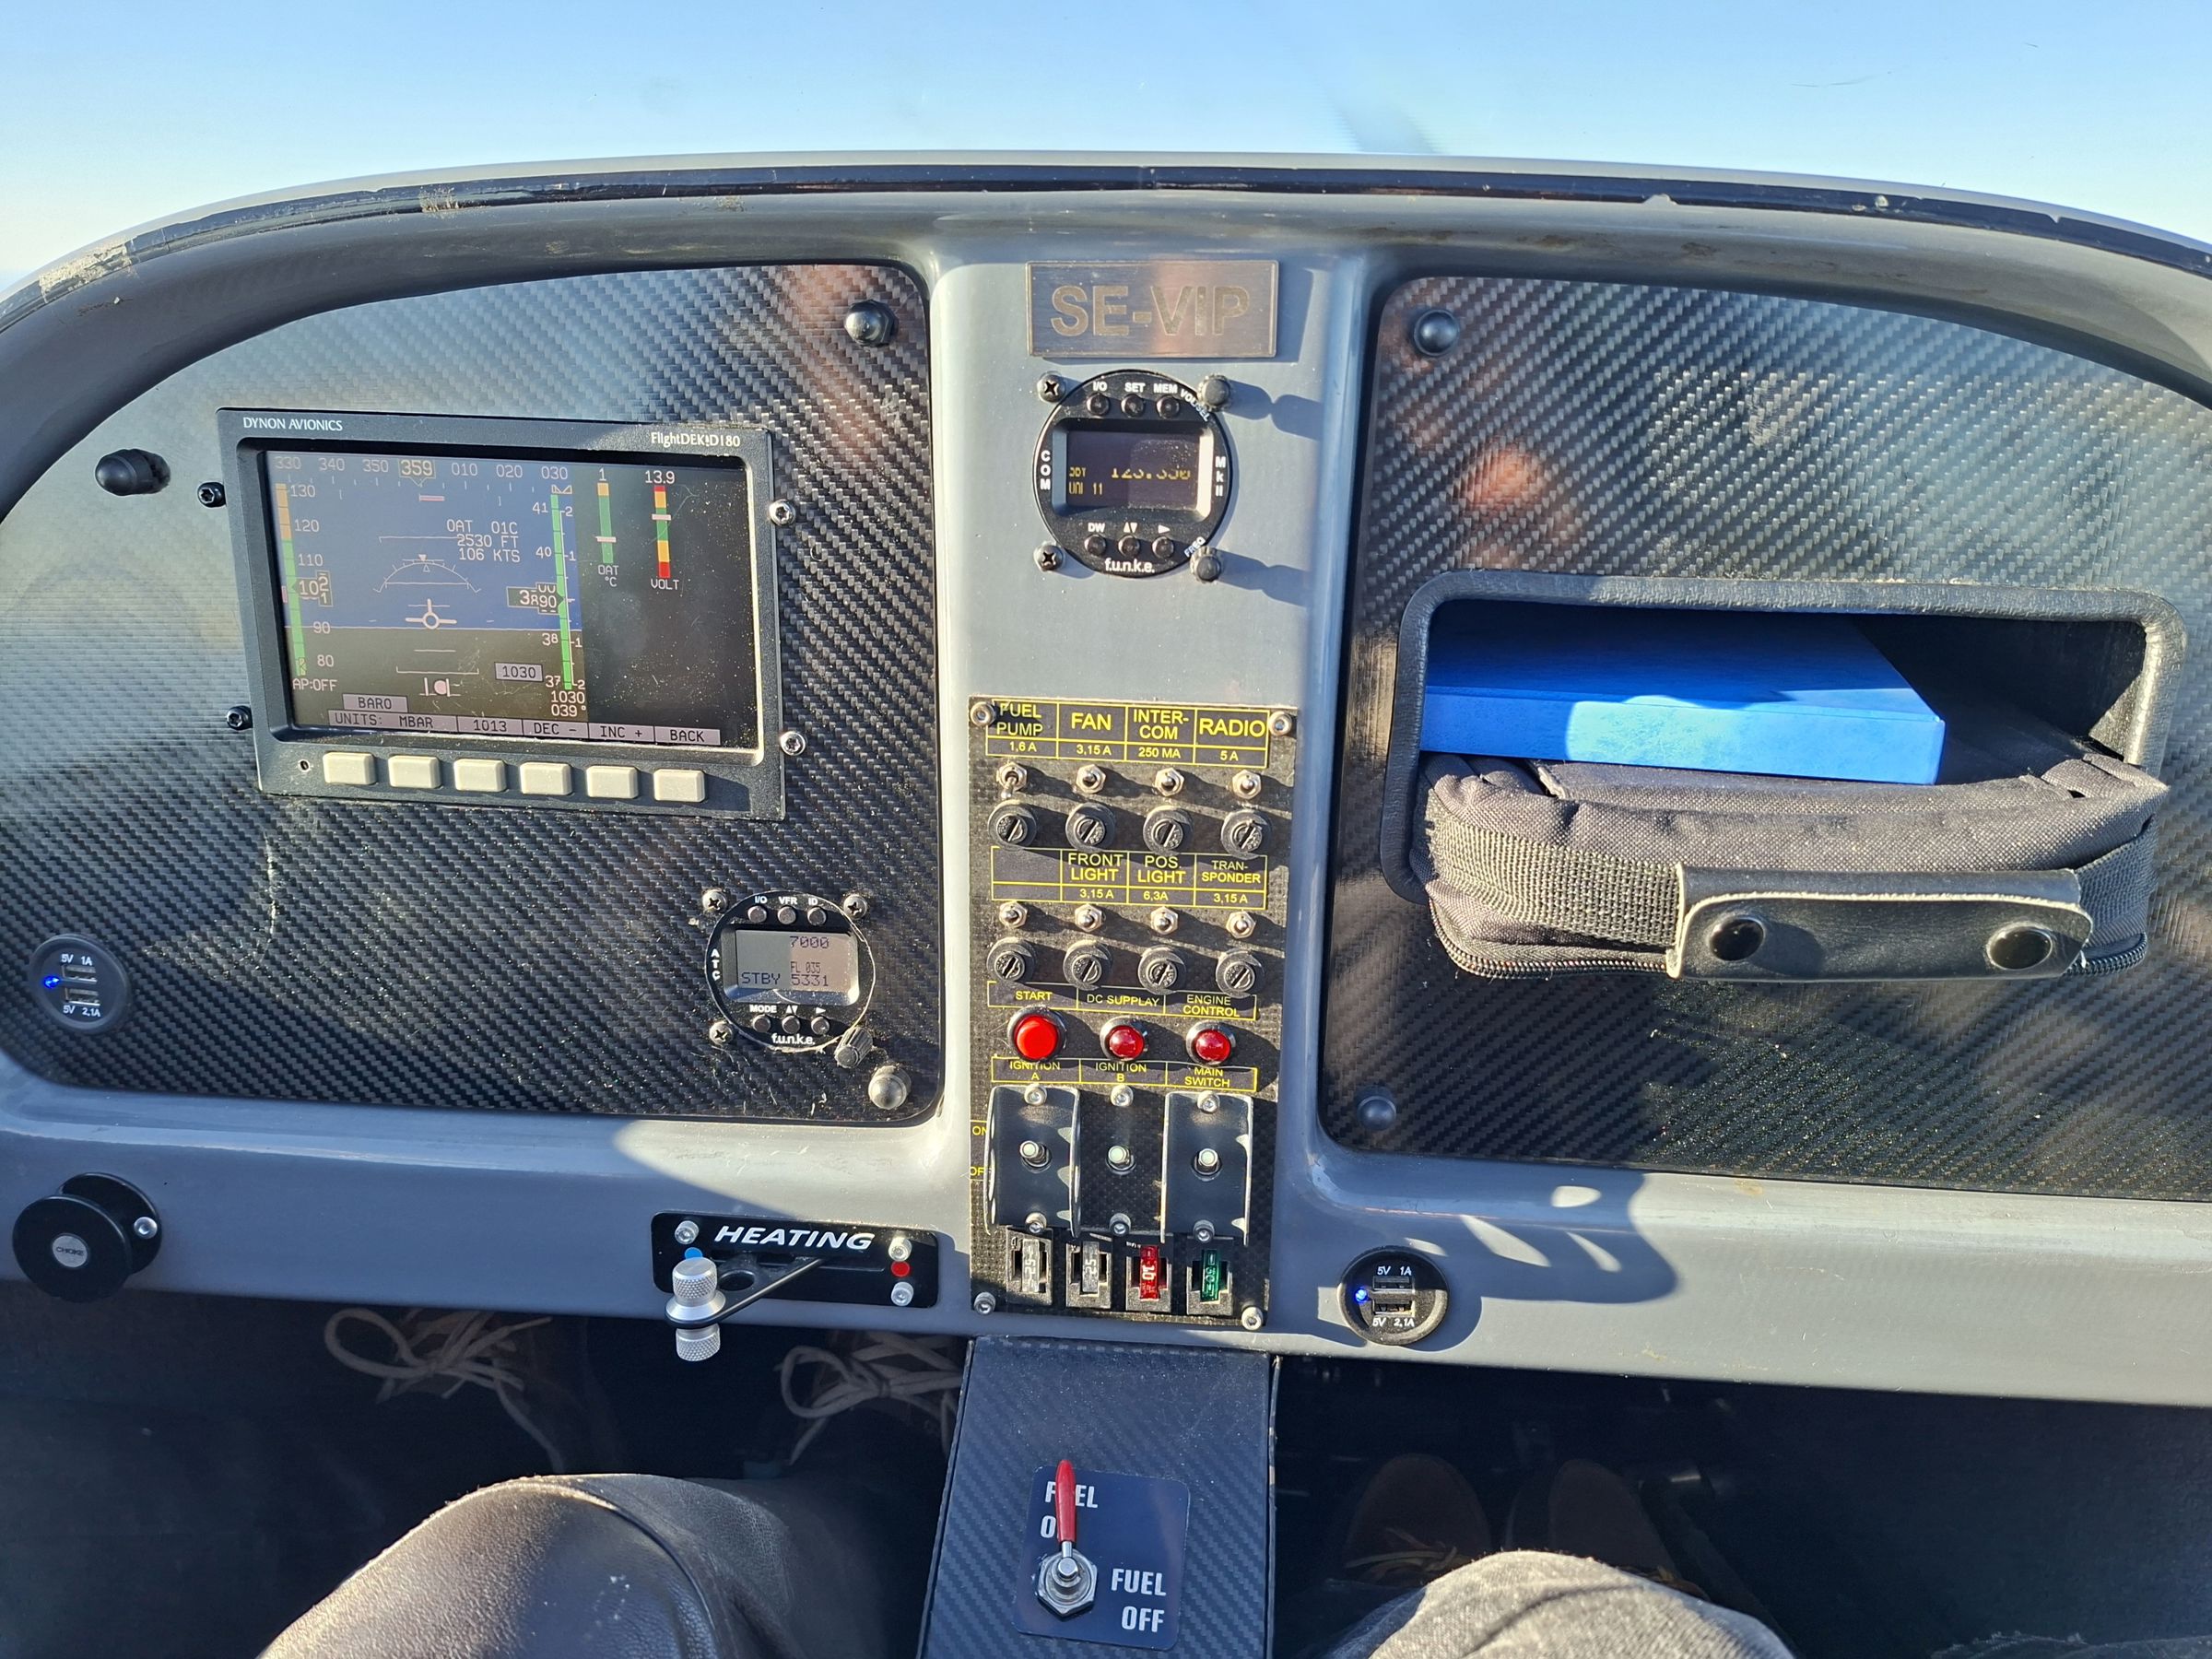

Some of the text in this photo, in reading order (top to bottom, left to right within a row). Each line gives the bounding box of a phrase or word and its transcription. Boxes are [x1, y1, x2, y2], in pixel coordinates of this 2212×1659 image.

[1051, 285, 1250, 335] SE-VIP
[1124, 382, 1145, 393] SET
[1153, 383, 1177, 394] MEM
[242, 417, 343, 431] DYNON AVIONICS
[275, 456, 301, 469] 330
[318, 458, 345, 471] 340
[362, 459, 389, 473] 350
[400, 460, 433, 477] 359
[451, 463, 478, 477] 010
[496, 465, 523, 478] 020
[541, 466, 568, 479] 030
[599, 468, 606, 481] 1
[645, 470, 676, 484] 13.9
[289, 484, 316, 498] 130
[532, 502, 548, 514] 41
[294, 519, 319, 533] 120
[1088, 522, 1105, 532] DW
[457, 535, 518, 548] 2530 FT
[459, 547, 521, 563] 106 KTS
[535, 547, 552, 558] 40
[298, 553, 324, 566] 110
[597, 564, 619, 576] OAT
[651, 579, 679, 591] VOLT
[312, 622, 331, 634] 90
[542, 632, 559, 646] 38
[317, 654, 335, 667] 80
[501, 665, 536, 678] 1030
[292, 678, 337, 691] AP:OFF
[545, 675, 561, 688] 37
[358, 697, 393, 710] BARO
[550, 690, 585, 704] 1030
[998, 702, 1042, 718] FUEL
[1133, 709, 1189, 724] INTER-
[335, 713, 433, 729] UNITS: MBAR
[473, 720, 507, 732] 1013
[1071, 712, 1112, 731] FAN
[534, 723, 559, 735] DEC
[600, 725, 626, 738] INC
[996, 722, 1043, 736] PUMP
[1139, 725, 1178, 740] COM
[1198, 719, 1265, 738] RADIO
[670, 729, 705, 743] BACK
[1029, 742, 1037, 753] A
[1102, 746, 1112, 756] A
[1138, 747, 1181, 759] 250 MA
[1220, 750, 1239, 761] 5 A
[1067, 853, 1124, 867] FRONT
[1144, 855, 1179, 869] POS.
[1211, 860, 1248, 871] TRAN-
[1071, 867, 1119, 882] LIGHT
[1137, 870, 1186, 884] LIGHT
[1201, 872, 1261, 885] SPONDER
[1105, 888, 1114, 900] A
[1240, 894, 1248, 904] A
[778, 897, 797, 905] VFR
[790, 935, 830, 948] 7000
[61, 953, 93, 966] 5V 1A
[741, 972, 781, 985] STBY
[791, 973, 829, 986] 5331
[1015, 991, 1053, 1001] START
[1087, 994, 1159, 1007] DC SUPPLAY
[1186, 994, 1231, 1006] ENGINE
[63, 1005, 75, 1014] 5V
[749, 1005, 777, 1013] MODE
[1182, 1006, 1241, 1018] CONTROL
[1095, 1062, 1147, 1073] IGNITION
[1194, 1067, 1224, 1077] MAIN
[1030, 1072, 1040, 1080] A
[1116, 1074, 1125, 1082] B
[1184, 1077, 1230, 1088] SWITCH
[714, 1225, 876, 1250] HEATING
[56, 1246, 84, 1256] CHOKE
[1025, 1259, 1036, 1275] 25
[1086, 1259, 1097, 1275] 25
[1377, 1265, 1412, 1276] 5V 1A
[1372, 1317, 1386, 1327] 5V
[1045, 1481, 1098, 1508] FEL
[1041, 1515, 1058, 1538] O
[1111, 1568, 1166, 1596] FUEL
[1121, 1606, 1164, 1632] OFF
